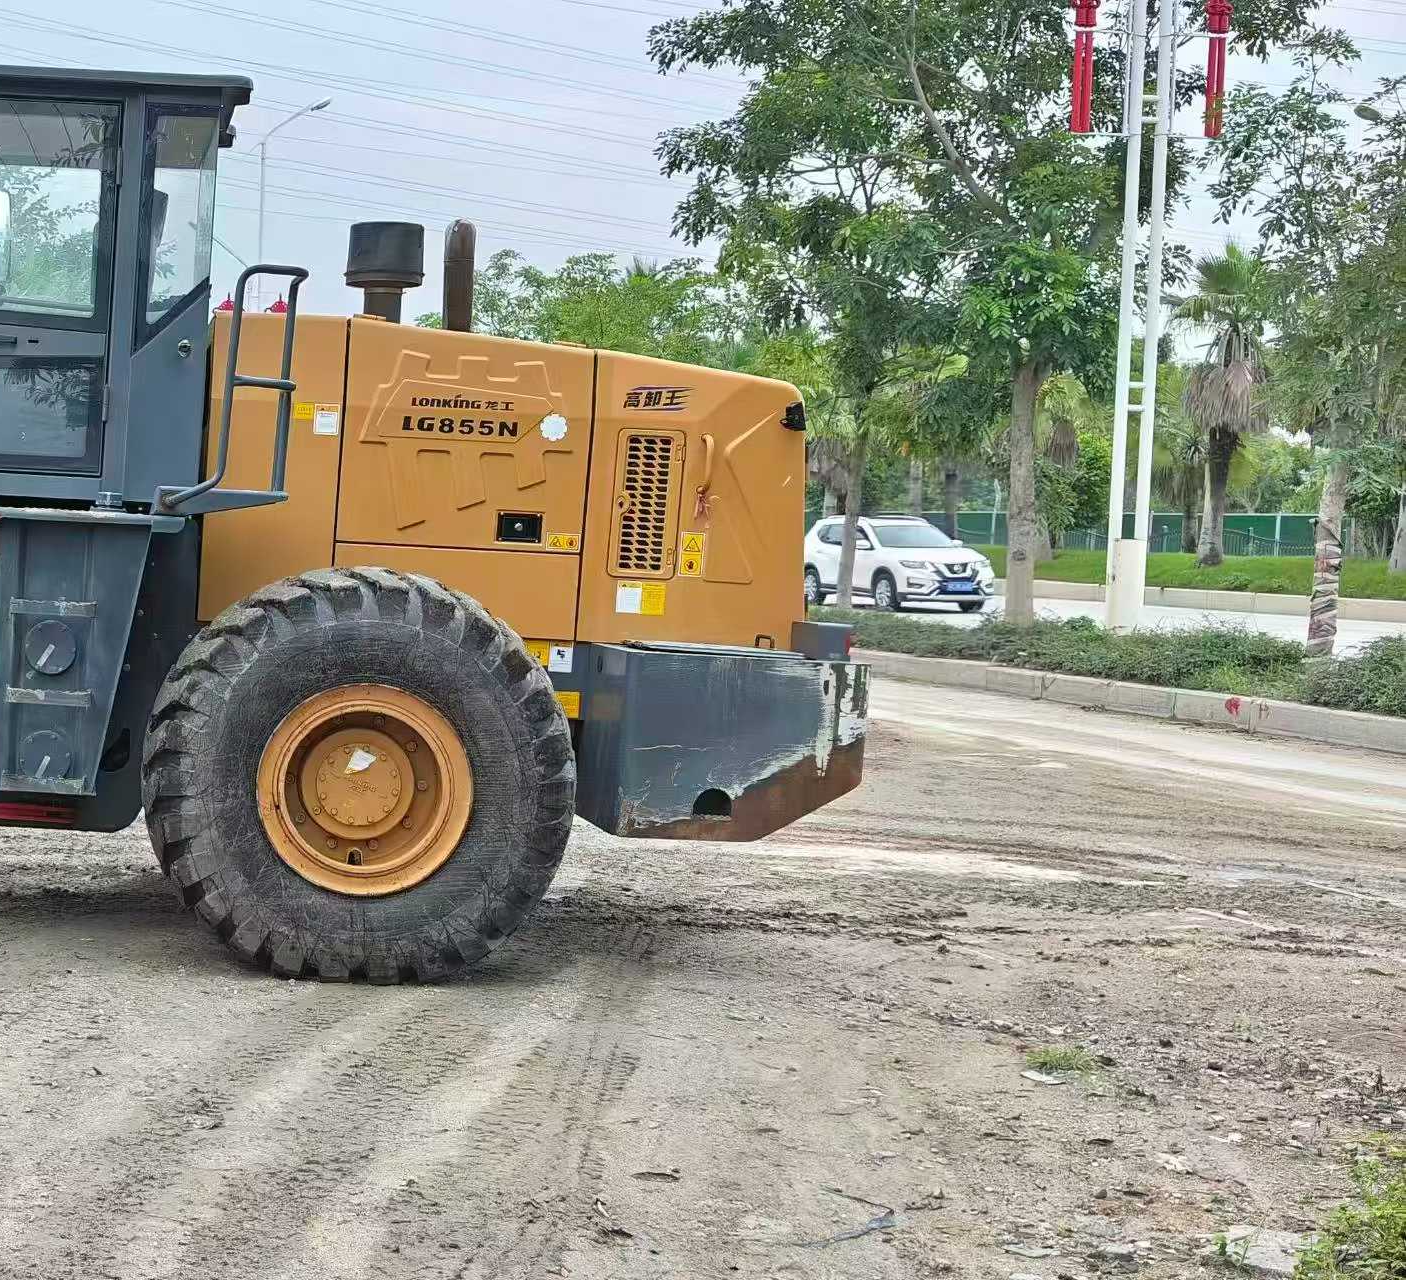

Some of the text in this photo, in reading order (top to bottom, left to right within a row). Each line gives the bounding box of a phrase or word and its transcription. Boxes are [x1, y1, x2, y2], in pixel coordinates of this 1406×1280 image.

[484, 401, 515, 411] 龙工
[623, 391, 690, 408] 高卸王
[402, 415, 519, 438] LG855N
